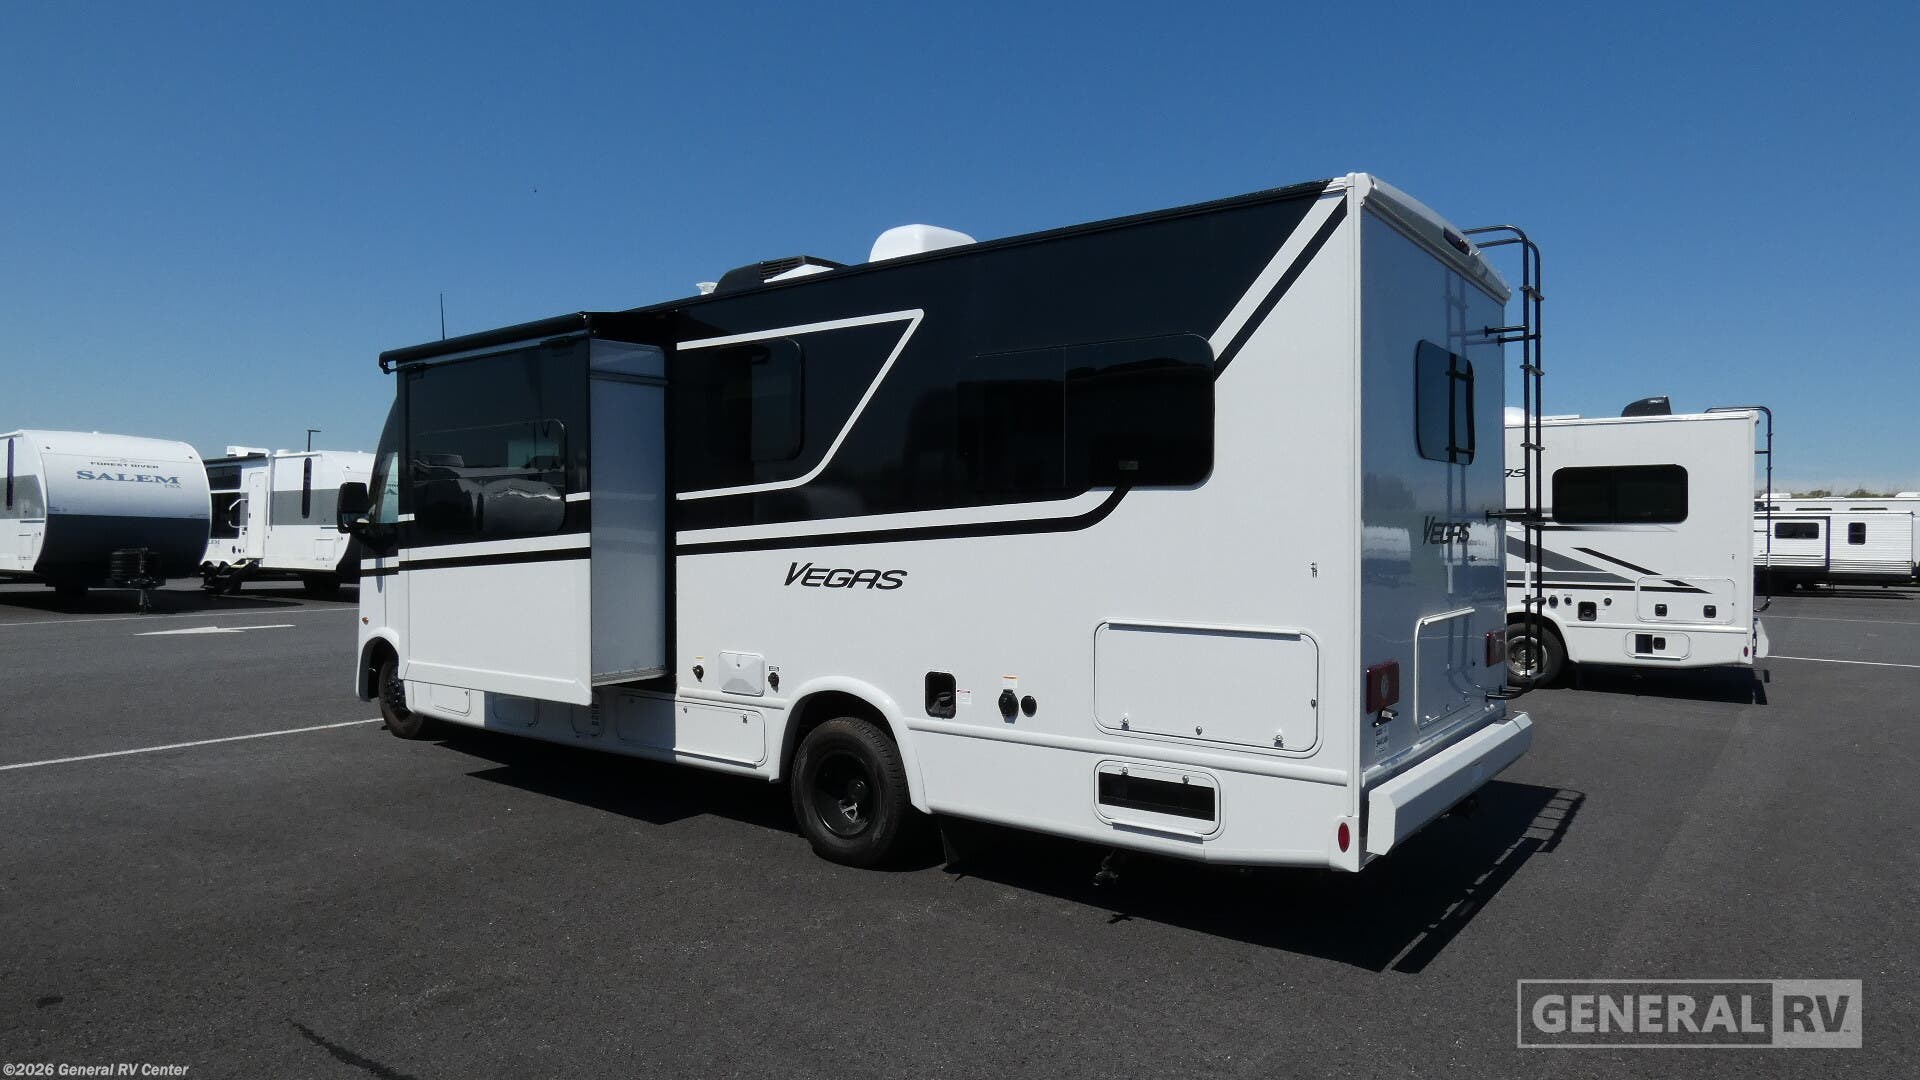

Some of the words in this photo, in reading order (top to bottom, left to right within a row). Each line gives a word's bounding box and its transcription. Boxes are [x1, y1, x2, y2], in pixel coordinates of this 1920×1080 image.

[76, 470, 181, 485] SALEM
[1423, 515, 1471, 546] VEGAS
[784, 561, 908, 590] VEGAS
